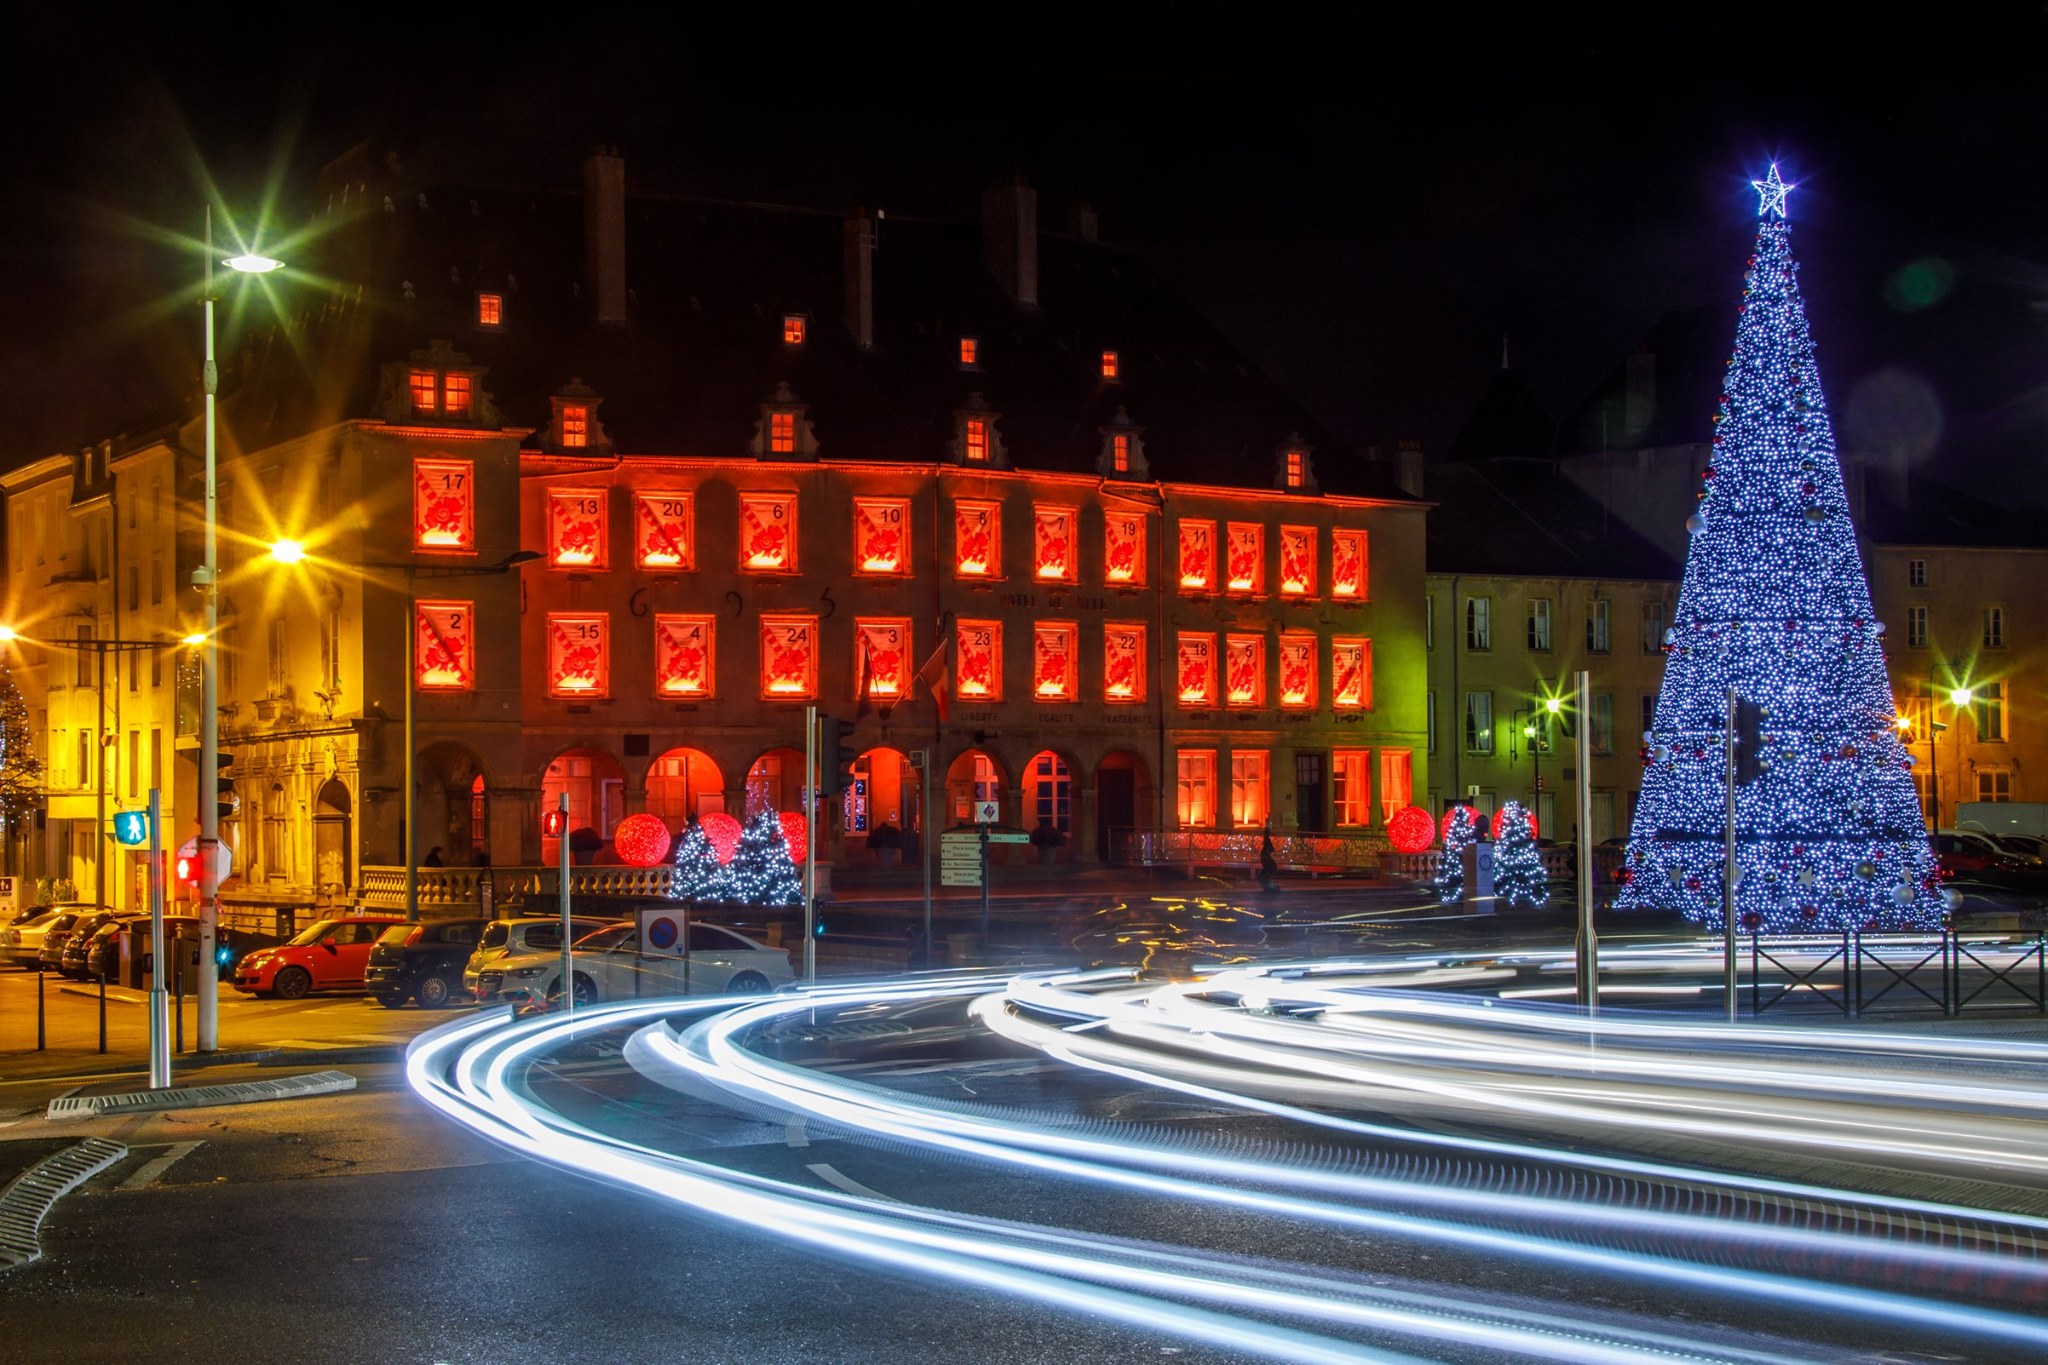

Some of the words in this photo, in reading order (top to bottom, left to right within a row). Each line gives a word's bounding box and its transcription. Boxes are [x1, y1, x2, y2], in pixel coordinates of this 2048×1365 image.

[442, 475, 464, 490] 17
[577, 501, 597, 514] 13
[663, 502, 684, 517] 20
[773, 505, 782, 519] 6
[881, 509, 900, 522] 10
[979, 513, 986, 525] 8
[1057, 518, 1064, 531] 7
[1122, 523, 1135, 535] 19
[1193, 530, 1206, 542] 11
[1242, 533, 1255, 544] 14
[1296, 536, 1307, 548] 21
[1351, 540, 1356, 551] 9
[450, 614, 461, 628] 2
[578, 625, 599, 639] 15
[690, 627, 700, 640] 4
[787, 628, 807, 642] 24
[889, 630, 897, 643] 3
[975, 632, 990, 645] 23
[1056, 635, 1063, 646] 1
[1121, 636, 1135, 649] 22
[1195, 644, 1207, 655] 18
[1246, 645, 1252, 657] 5
[1296, 648, 1308, 659] 12
[1348, 649, 1361, 660] 16
